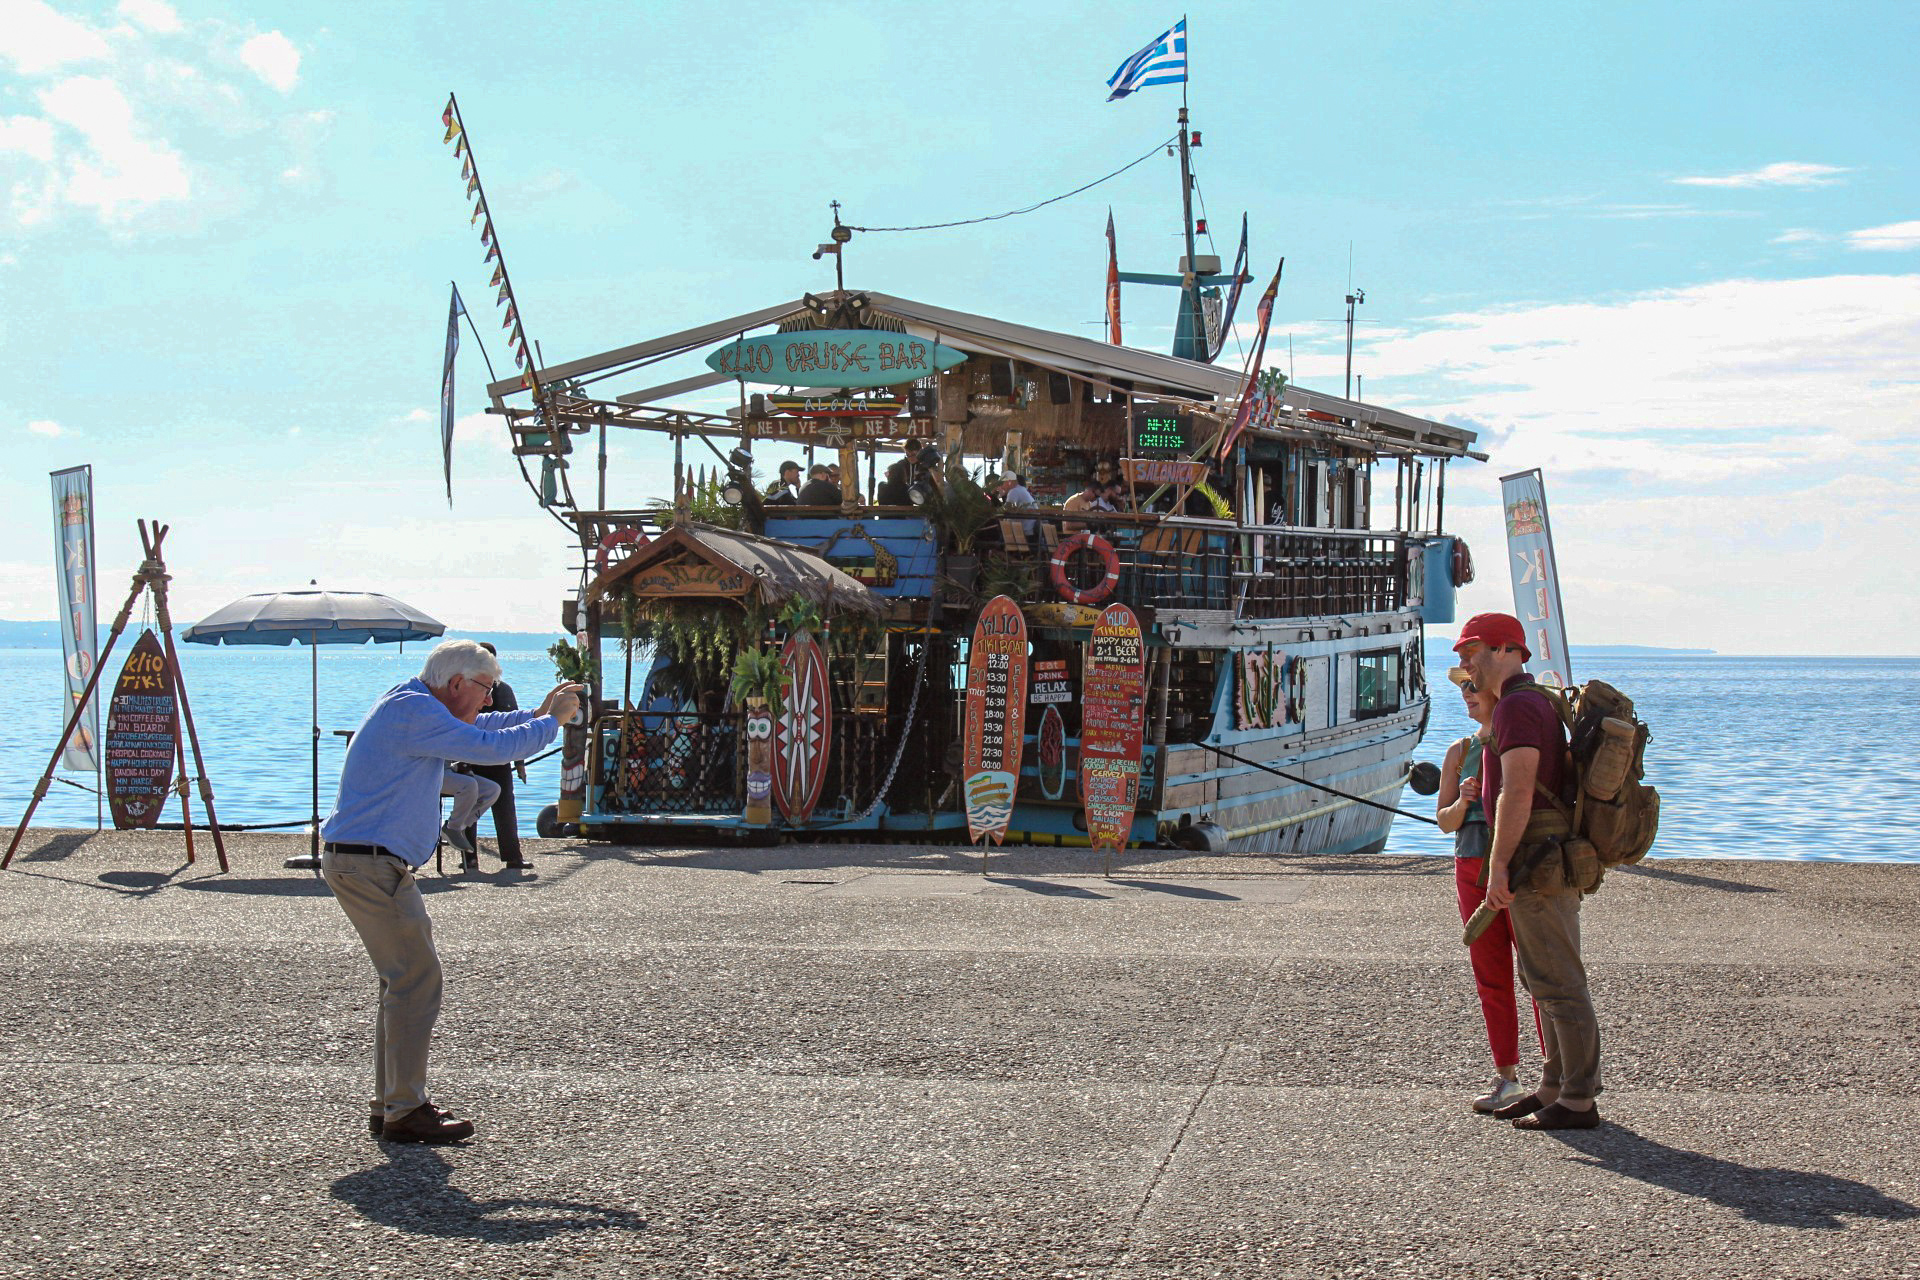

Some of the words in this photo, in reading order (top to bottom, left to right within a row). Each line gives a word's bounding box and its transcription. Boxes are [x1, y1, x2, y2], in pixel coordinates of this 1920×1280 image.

[720, 344, 773, 373] KLIO
[786, 342, 871, 372] CRUISE
[879, 342, 927, 370] BAR
[804, 398, 869, 411] ALOHA
[1139, 433, 1185, 448] CRUISE
[979, 614, 1020, 636] KLIO
[1093, 636, 1120, 645] HAPPY
[1121, 637, 1140, 647] HOUR
[1000, 640, 1025, 657] BOAT
[1115, 646, 1137, 656] BEER
[988, 660, 1008, 669] 12:00
[971, 667, 986, 682] 30
[1038, 671, 1063, 680] DRINK
[986, 685, 1006, 694] 15:00
[1035, 681, 1067, 693] RELAX
[968, 687, 985, 697] min
[985, 697, 1005, 706] 16:30
[1044, 693, 1066, 701] HAPPY
[984, 710, 1004, 719] 18:00
[1011, 707, 1019, 719] &
[118, 723, 130, 731] ON
[133, 723, 166, 732] BOARD!
[983, 722, 1003, 732] 19:30
[983, 735, 1003, 744] 21:00
[982, 748, 1002, 757] 22:30
[981, 761, 1001, 770] 00:00
[1092, 770, 1125, 778] CERVEZA
[1098, 832, 1119, 840] DANCE
